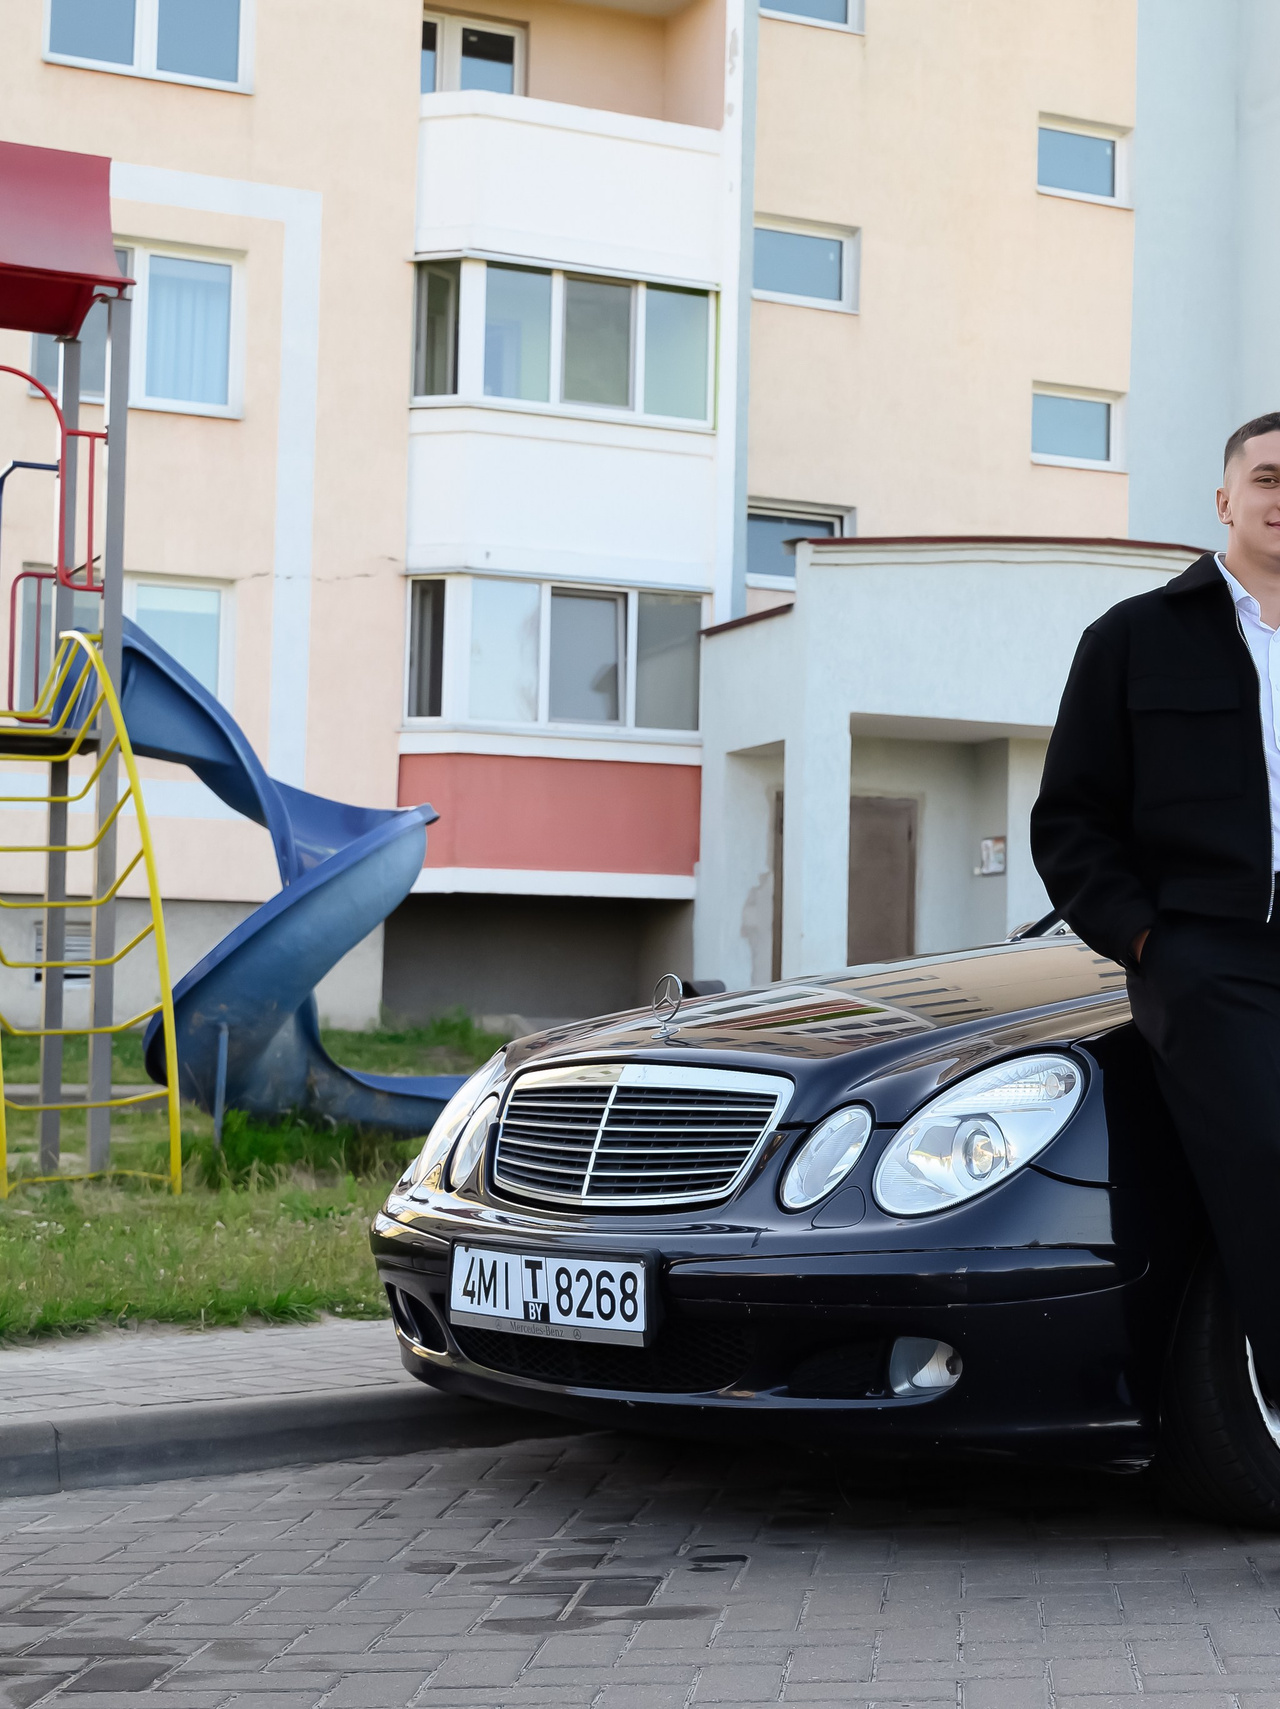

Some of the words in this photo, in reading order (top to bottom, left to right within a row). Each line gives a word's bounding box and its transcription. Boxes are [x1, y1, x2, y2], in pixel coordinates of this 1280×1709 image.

[524, 1259, 543, 1299] T
[555, 1266, 638, 1322] 8268
[528, 1303, 543, 1321] BY
[509, 1321, 565, 1338] Mercedes-Benz
